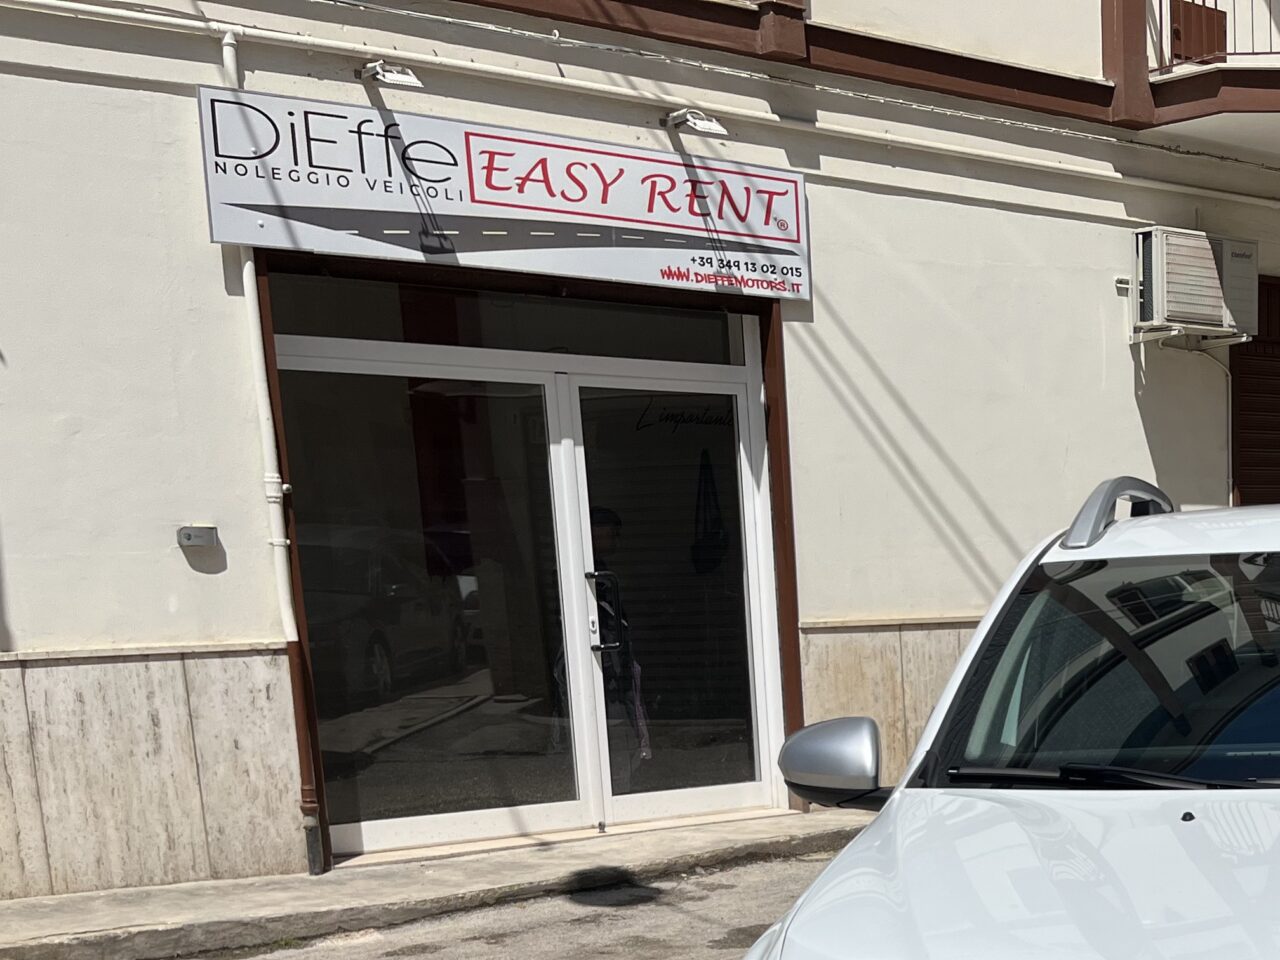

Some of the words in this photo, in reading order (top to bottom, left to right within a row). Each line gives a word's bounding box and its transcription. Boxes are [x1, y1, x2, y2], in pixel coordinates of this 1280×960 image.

[211, 99, 459, 182] DiEffe
[214, 161, 350, 188] NOLEGGIO
[366, 178, 463, 202] VEICOLI
[478, 150, 625, 204] EASY
[641, 174, 789, 226] RENT
[690, 256, 713, 268] +39
[718, 258, 741, 271] 349
[744, 262, 757, 273] 13
[761, 264, 777, 275] 02
[781, 266, 802, 278] 015
